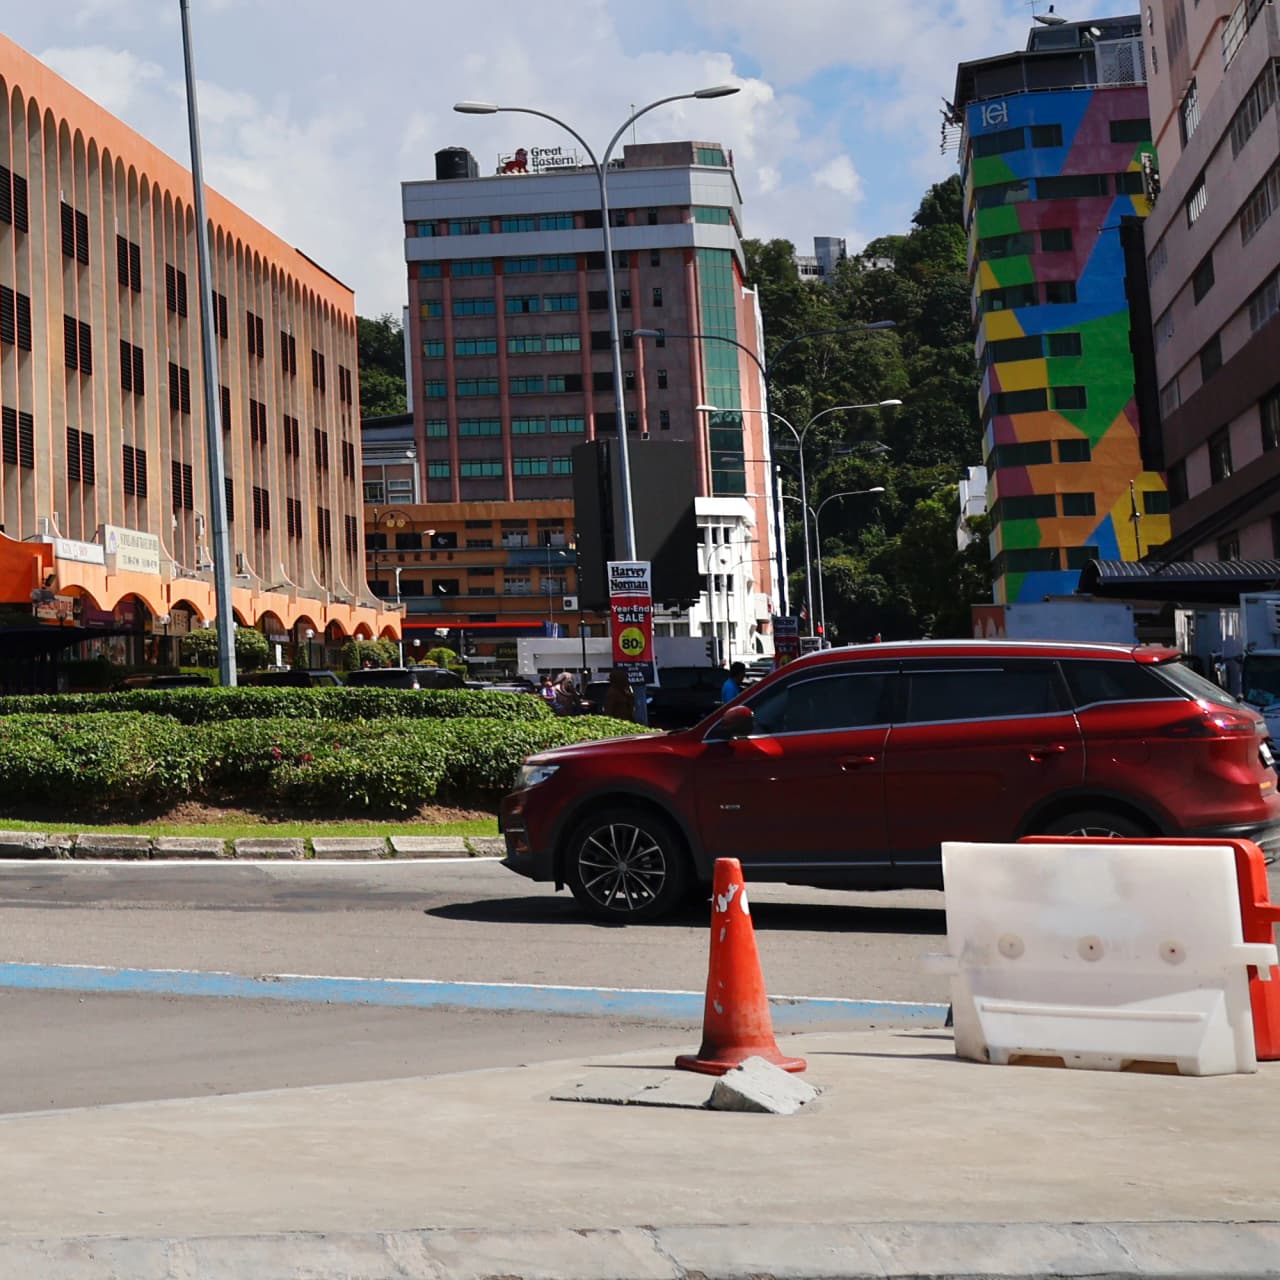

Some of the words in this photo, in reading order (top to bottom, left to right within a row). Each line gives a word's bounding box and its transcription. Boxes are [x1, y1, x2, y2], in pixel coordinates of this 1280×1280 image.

[531, 146, 561, 156] Great
[532, 156, 574, 167] Eastern
[611, 566, 647, 578] Harvey
[610, 579, 649, 590] Norman
[612, 605, 649, 613] Year-End
[618, 614, 644, 622] SALE
